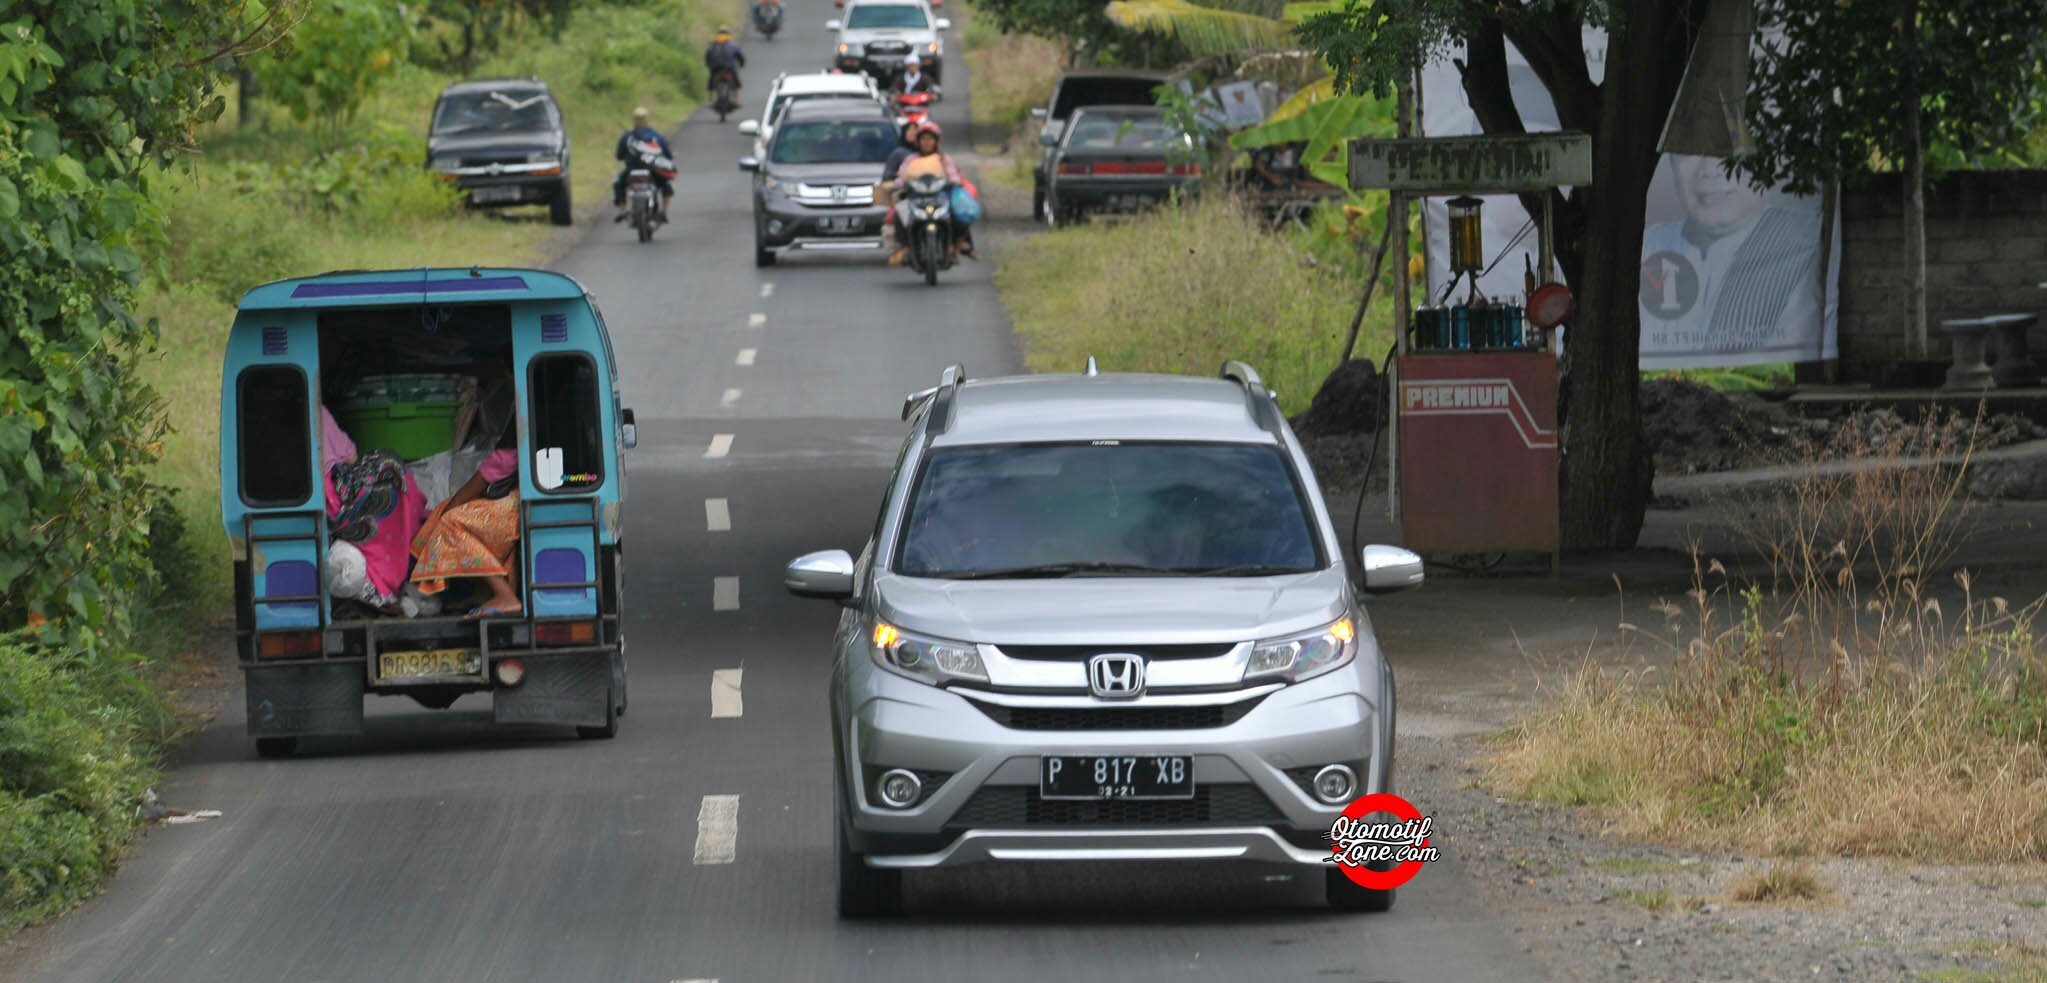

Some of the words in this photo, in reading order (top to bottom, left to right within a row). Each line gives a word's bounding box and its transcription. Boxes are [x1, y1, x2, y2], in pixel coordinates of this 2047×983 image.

[1406, 386, 1509, 408] PREMIUM
[1049, 758, 1062, 784] P
[1094, 758, 1137, 784] 817
[1156, 758, 1184, 784] XB
